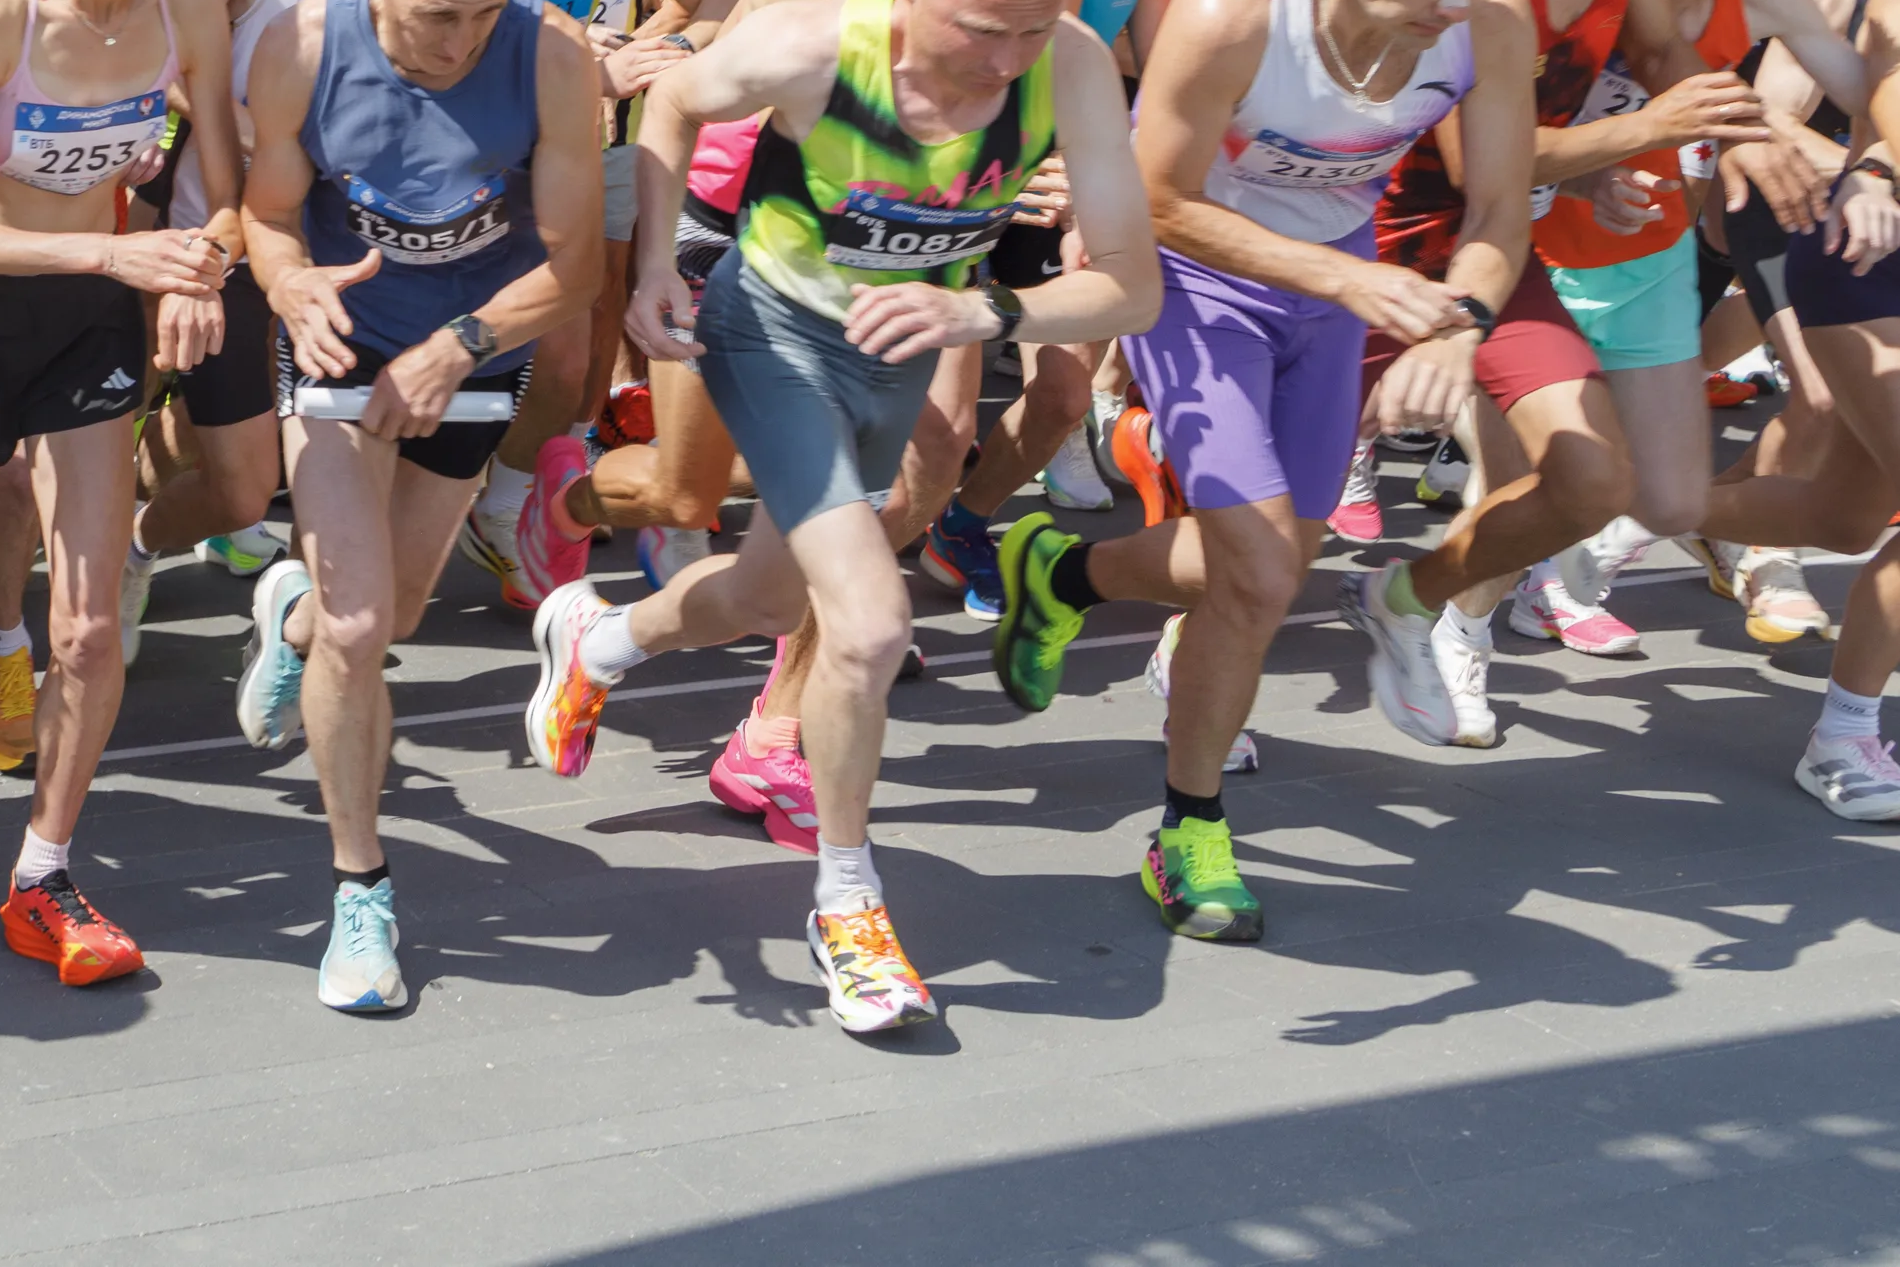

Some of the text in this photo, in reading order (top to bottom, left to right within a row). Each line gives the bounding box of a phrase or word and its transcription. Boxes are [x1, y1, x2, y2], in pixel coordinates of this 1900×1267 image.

[29, 139, 54, 149] ВТБ
[35, 140, 137, 174] 2253
[1266, 160, 1379, 179] 2130
[356, 212, 498, 251] 1205/1
[860, 228, 985, 255] 1087
